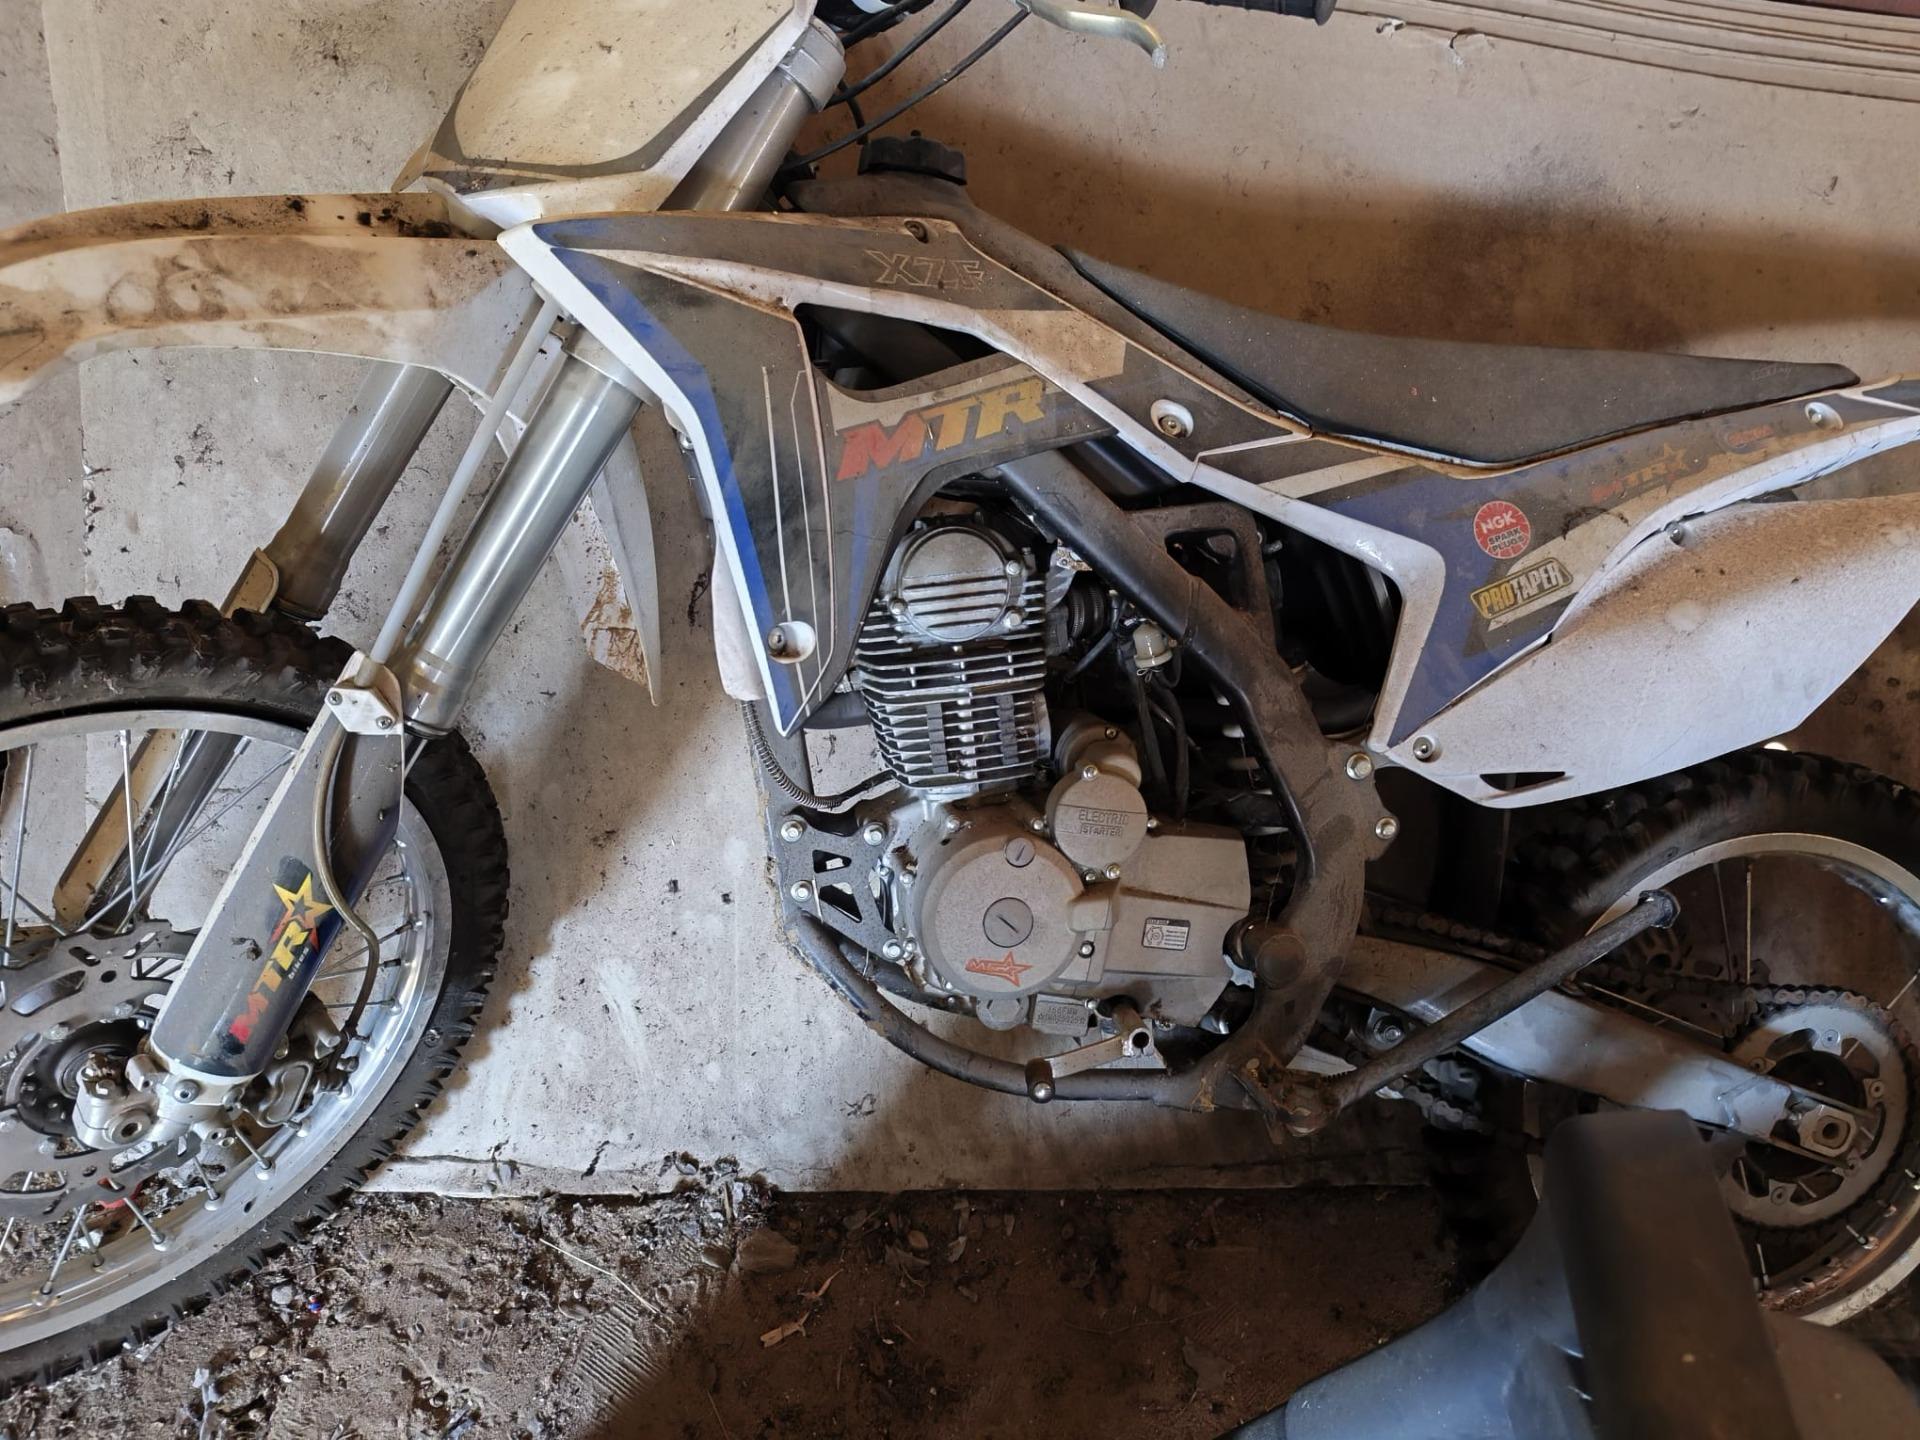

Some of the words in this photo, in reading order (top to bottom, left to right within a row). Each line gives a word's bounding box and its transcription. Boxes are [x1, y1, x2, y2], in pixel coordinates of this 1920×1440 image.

[836, 376, 1045, 480] MTR
[1480, 510, 1517, 533] NGK
[1487, 526, 1522, 545] SPARK
[1491, 534, 1525, 553] PLUGS
[1079, 808, 1129, 825] ELECTRIC
[1081, 823, 1121, 837] STARTER
[229, 920, 309, 1042] MTR
